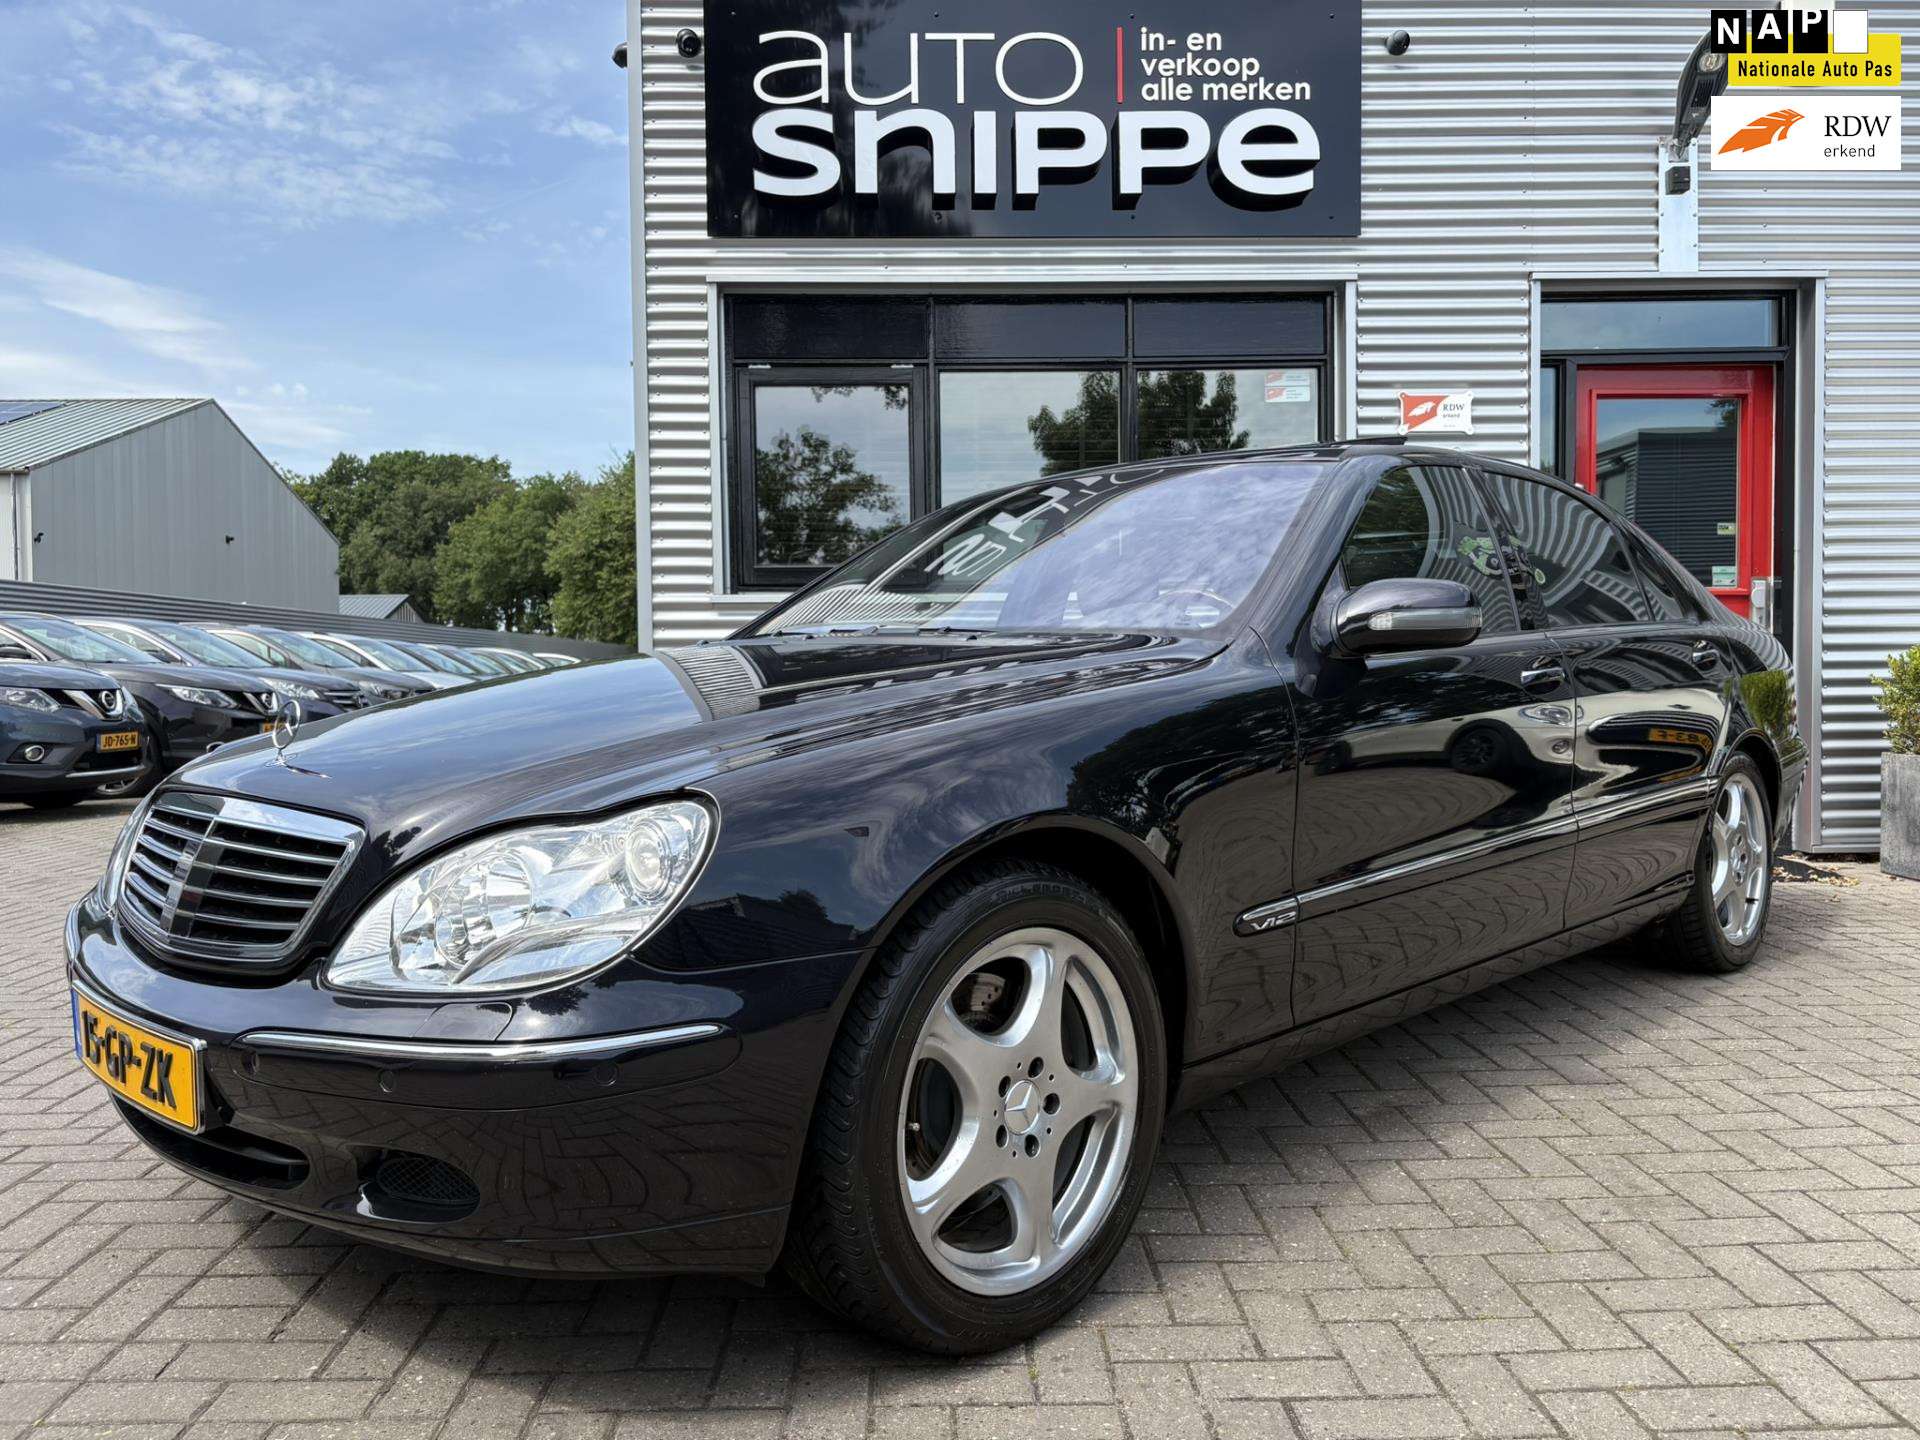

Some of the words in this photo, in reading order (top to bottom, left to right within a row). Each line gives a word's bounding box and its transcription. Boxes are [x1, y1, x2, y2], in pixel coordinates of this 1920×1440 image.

[1141, 27, 1176, 51] in-
[1187, 32, 1222, 51] en
[1141, 52, 1261, 81] verkoop
[1141, 77, 1193, 101] alle
[1203, 77, 1311, 101] merken
[1443, 403, 1465, 412] RDW
